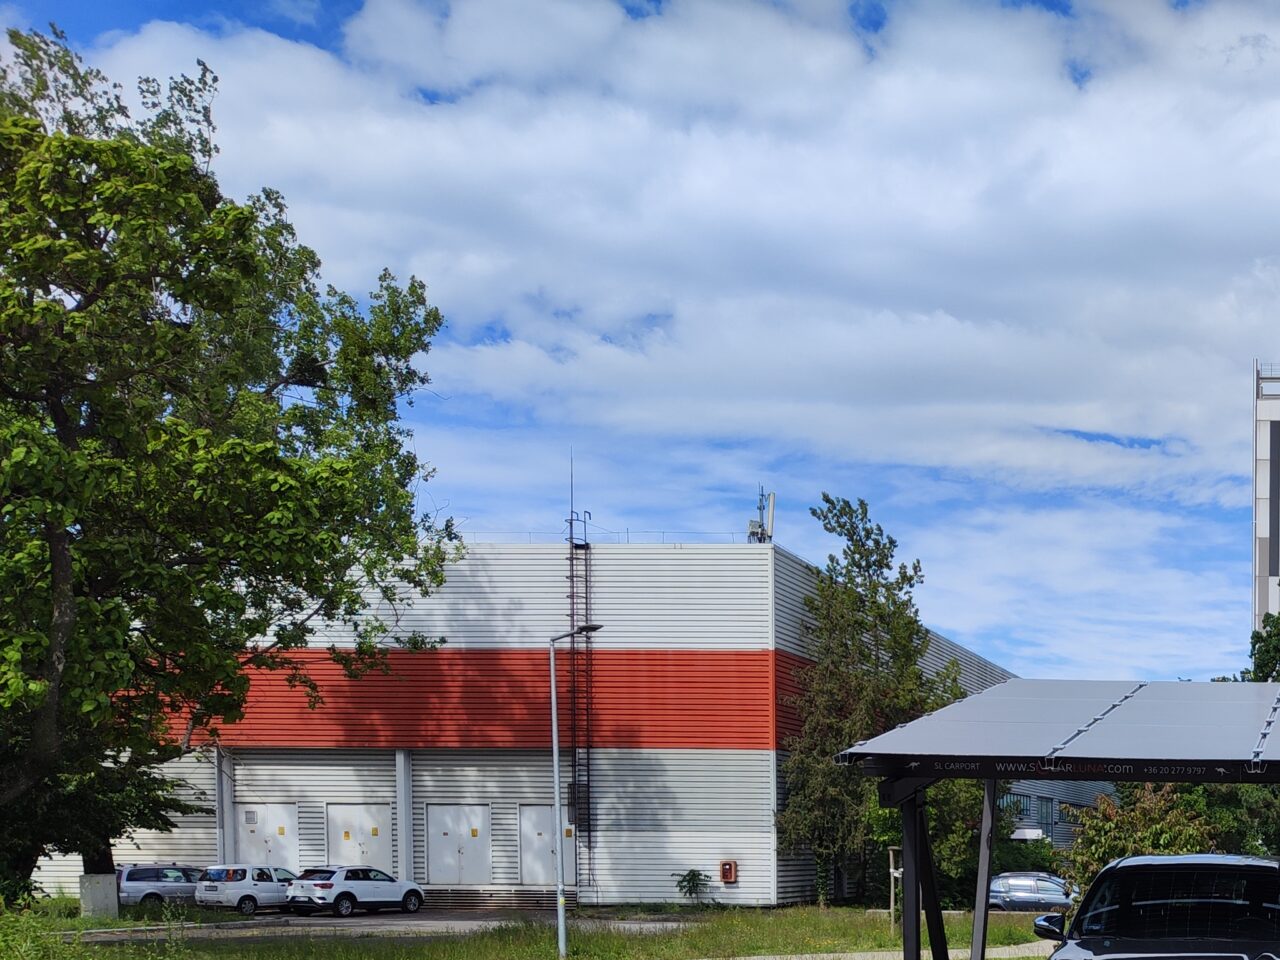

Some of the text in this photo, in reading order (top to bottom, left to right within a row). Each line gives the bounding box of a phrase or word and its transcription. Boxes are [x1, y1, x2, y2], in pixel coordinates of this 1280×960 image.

[934, 762, 980, 770] SL CARPORT
[1143, 766, 1206, 775] +36 20 277 9797
